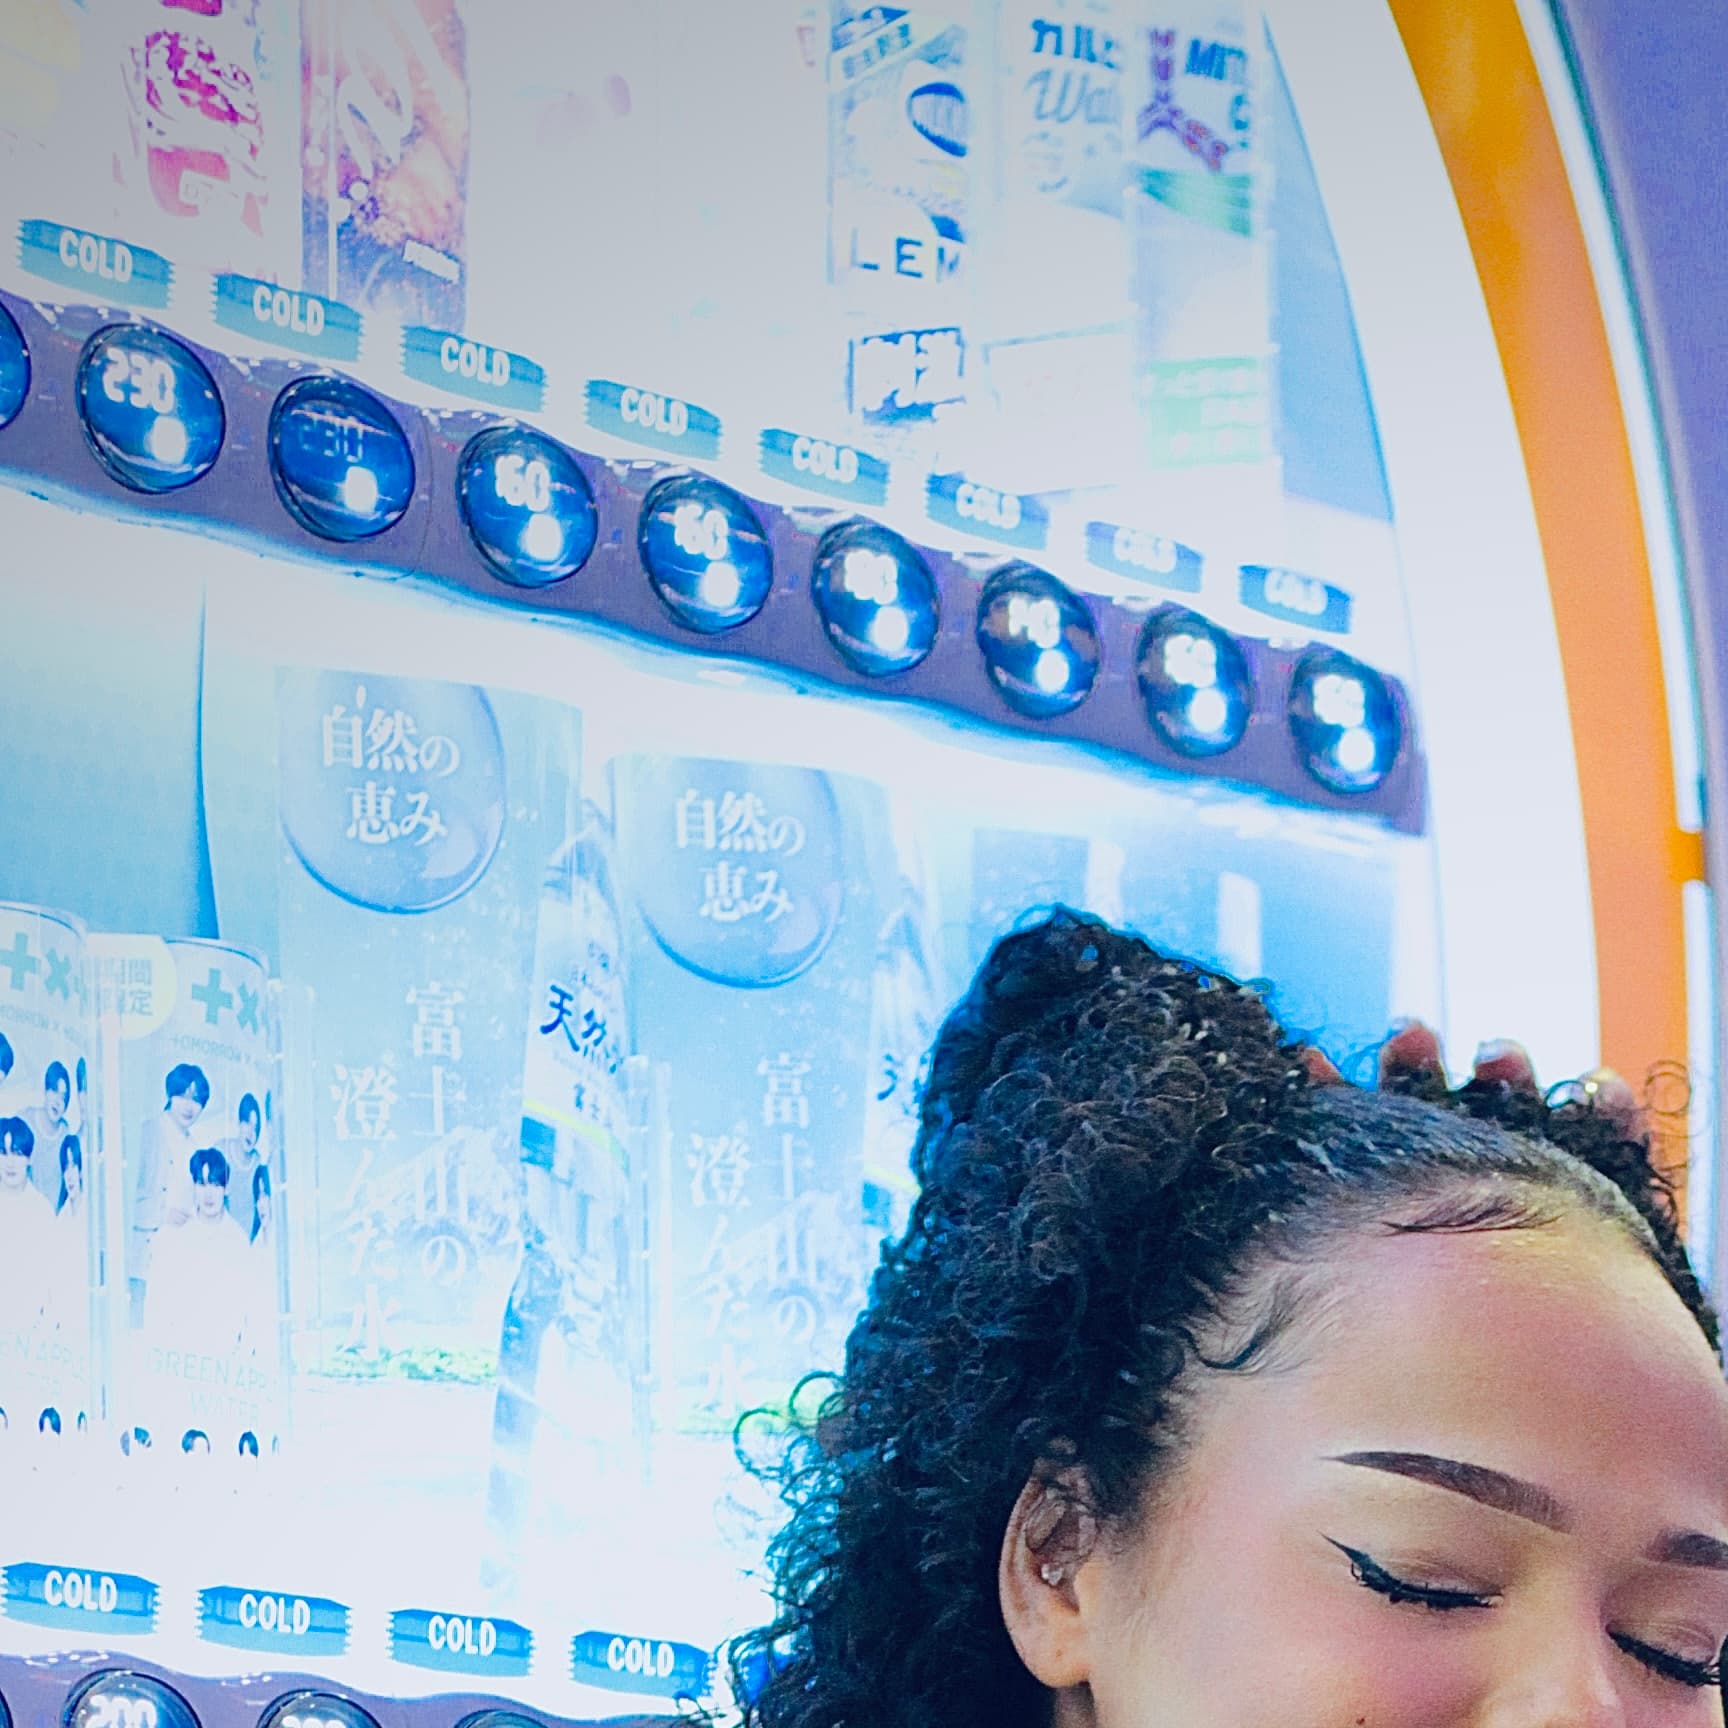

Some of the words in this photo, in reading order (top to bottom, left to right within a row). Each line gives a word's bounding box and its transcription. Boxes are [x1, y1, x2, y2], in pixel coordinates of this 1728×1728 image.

[59, 231, 133, 282] COLD
[253, 286, 325, 336] COLD
[102, 347, 175, 414] 230
[440, 338, 511, 386] COLD
[620, 387, 689, 435] COLD
[494, 454, 551, 512] 160
[793, 436, 858, 483] COLD
[321, 704, 460, 776] 自然の
[345, 780, 449, 846] 恵み
[676, 788, 805, 856] 自然の
[700, 860, 794, 922] 恵み
[45, 1571, 117, 1612] COLD
[238, 1594, 311, 1634] COLD
[428, 1615, 497, 1656] COLD
[607, 1637, 675, 1677] COLD
